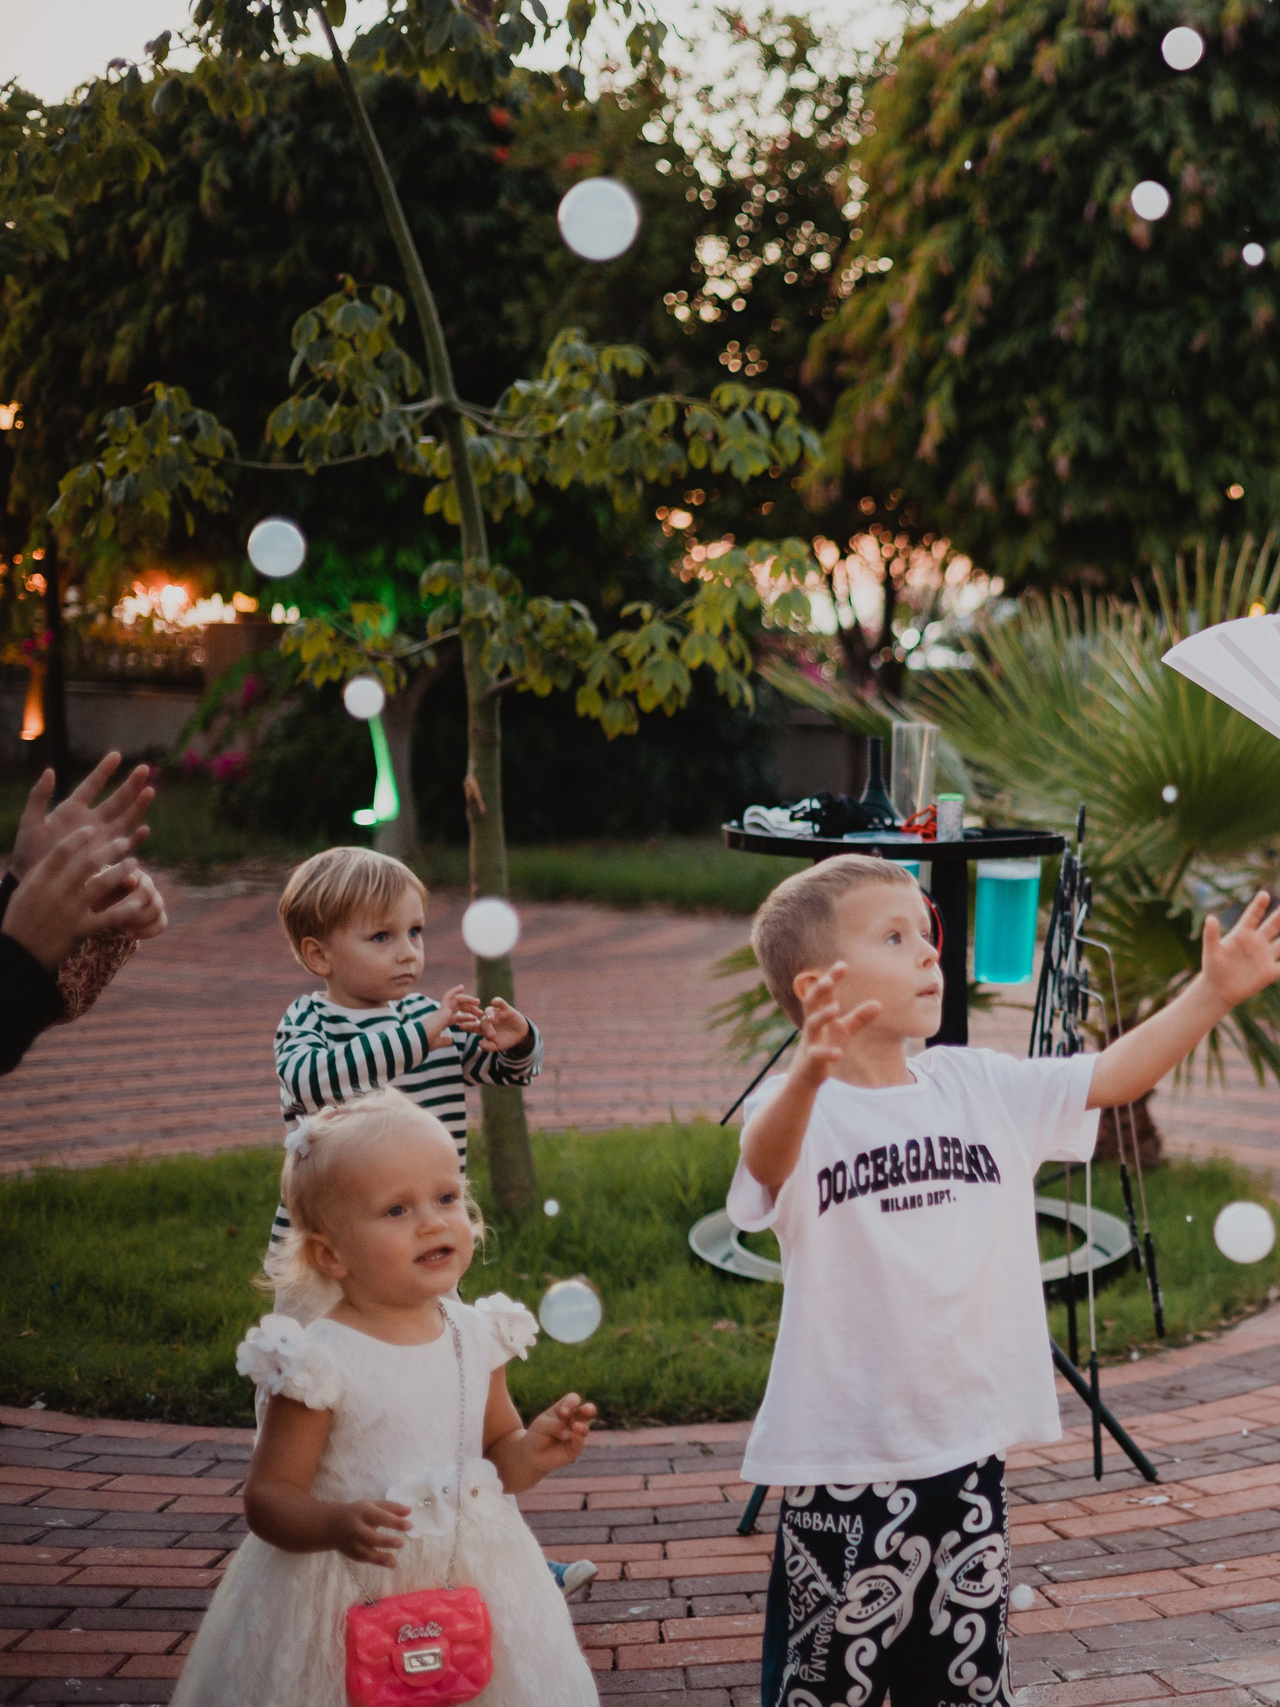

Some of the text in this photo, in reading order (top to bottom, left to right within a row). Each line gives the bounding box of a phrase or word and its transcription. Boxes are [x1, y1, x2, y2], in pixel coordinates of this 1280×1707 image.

[880, 1189, 957, 1213] MILANO DEPT.
[785, 1510, 864, 1535] GABBANA
[397, 1620, 444, 1645] Barbie
